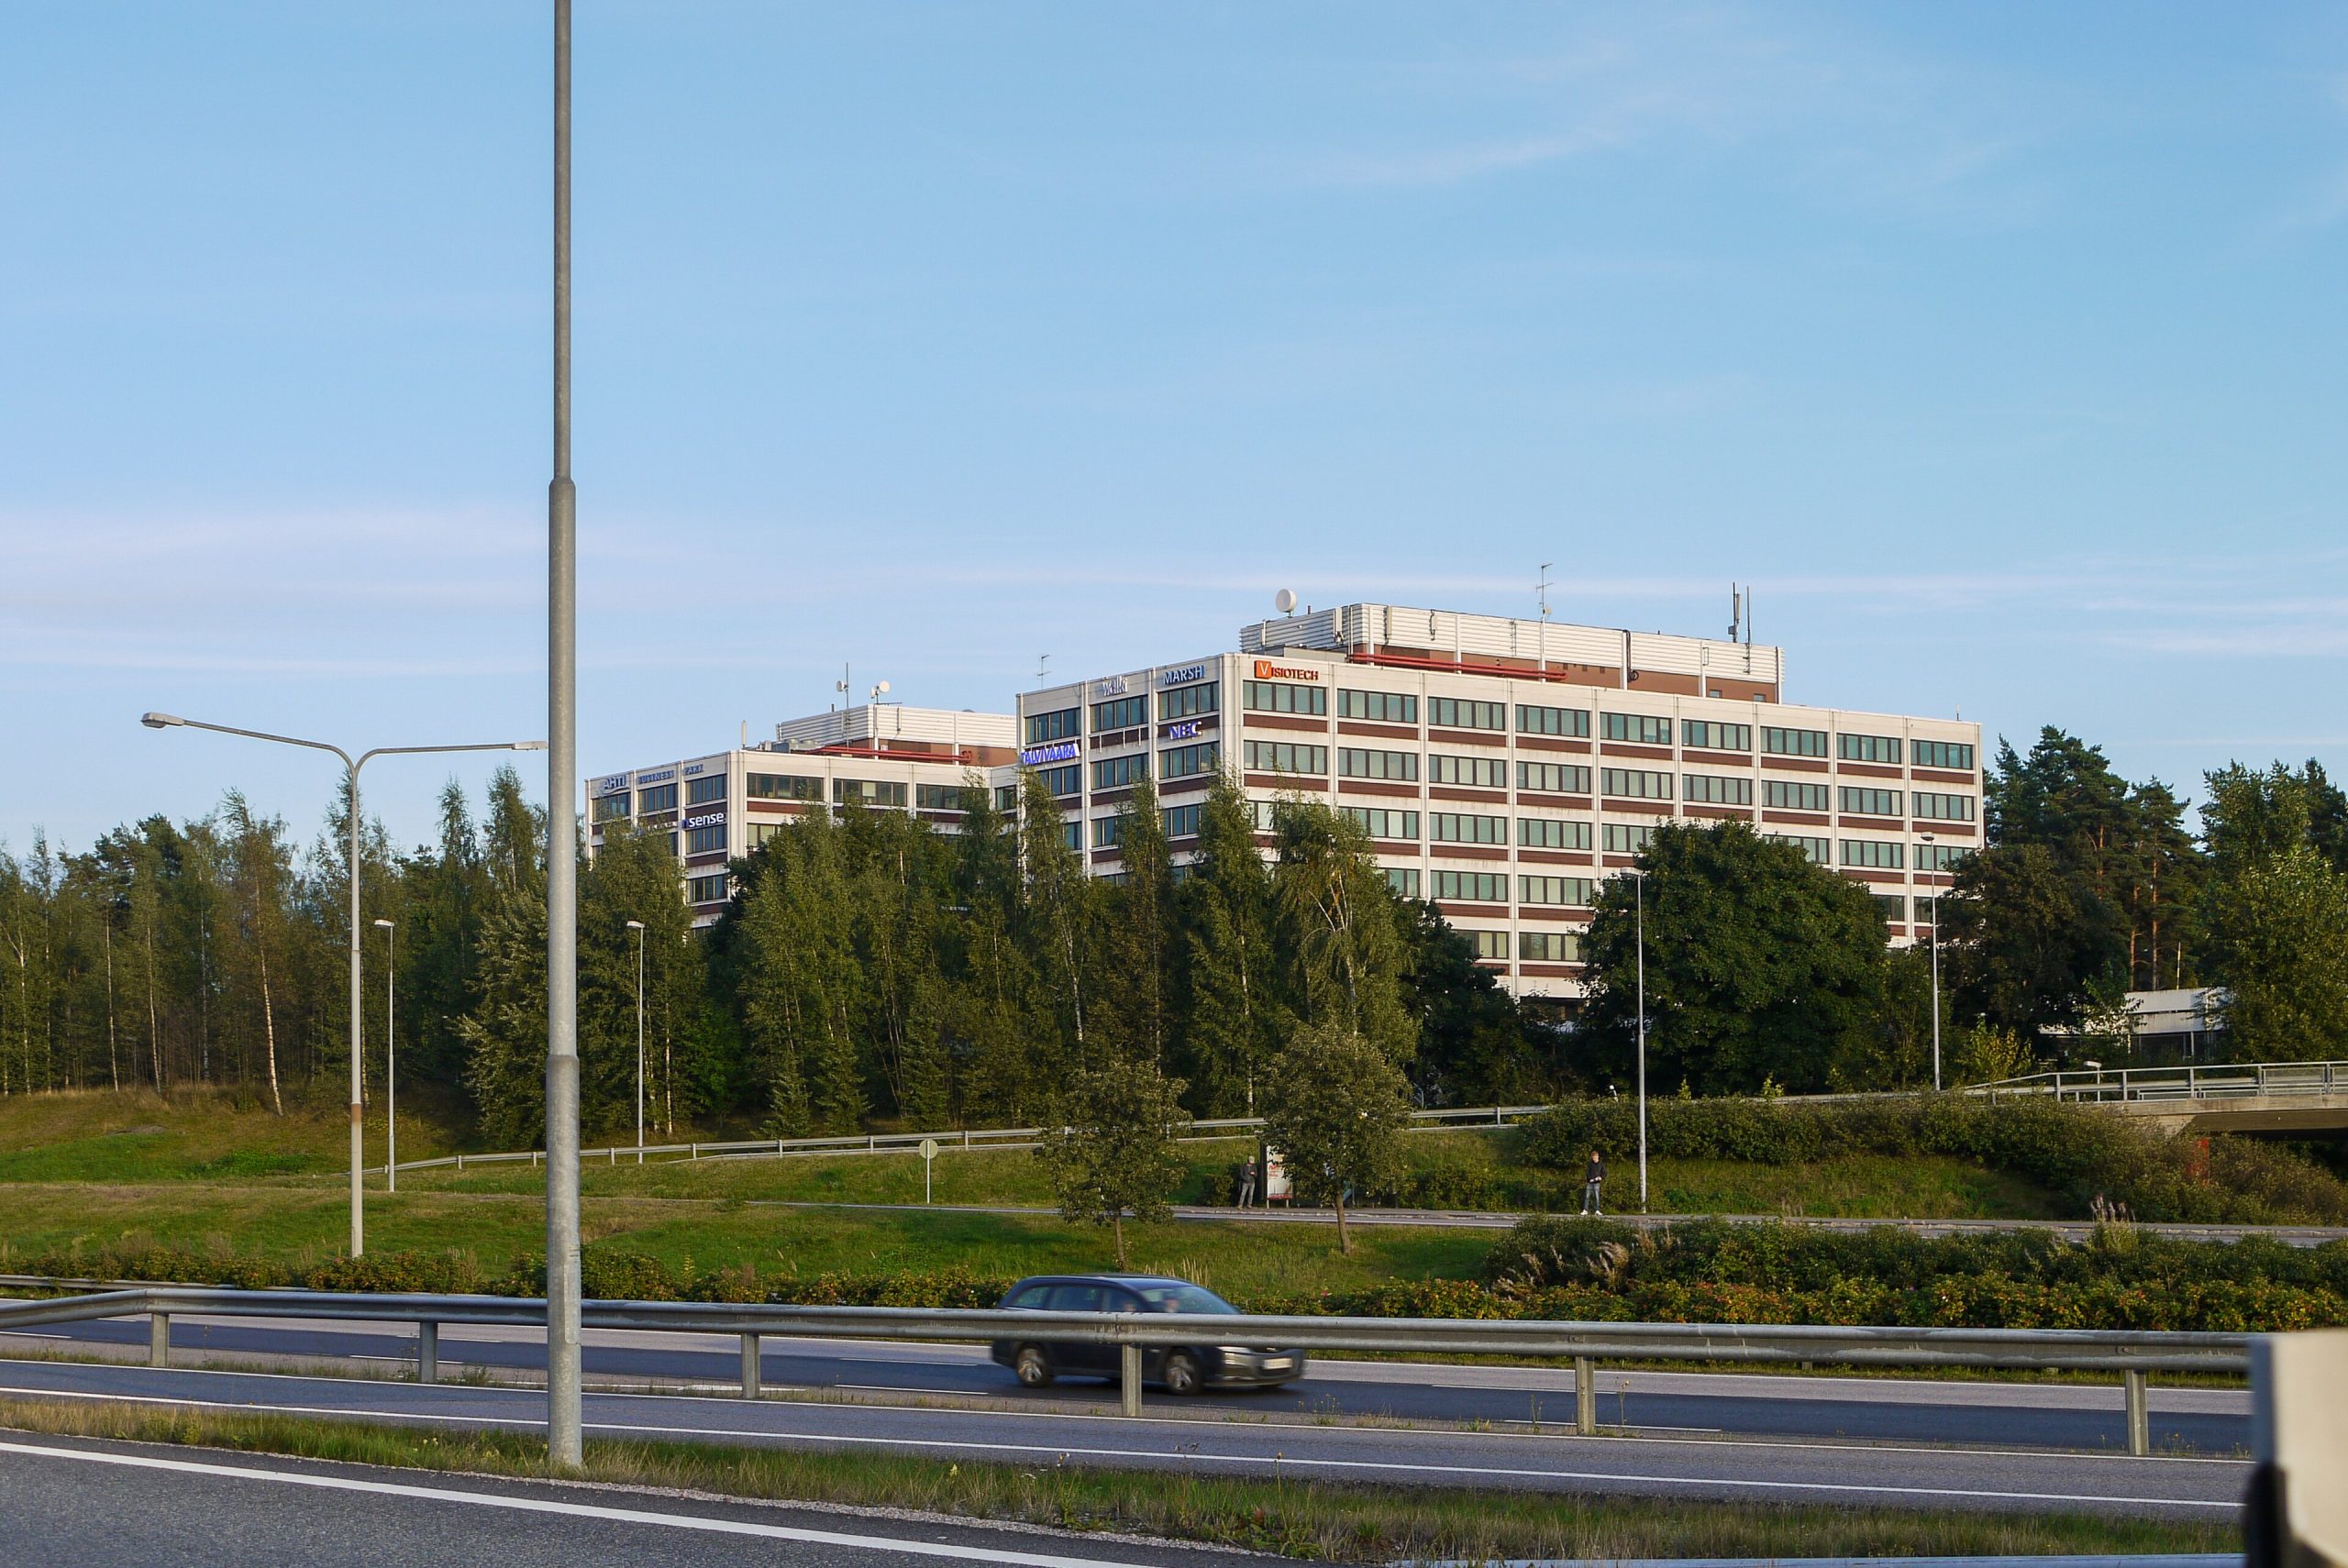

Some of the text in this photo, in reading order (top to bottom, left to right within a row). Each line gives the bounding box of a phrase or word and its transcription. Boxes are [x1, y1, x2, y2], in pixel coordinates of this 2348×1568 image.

[1163, 665, 1205, 685] MARSH
[1258, 661, 1319, 680] VISIOTECH
[1169, 720, 1202, 740] NEC
[1021, 742, 1080, 765] TALVIVAARA
[604, 775, 627, 789] AHTI
